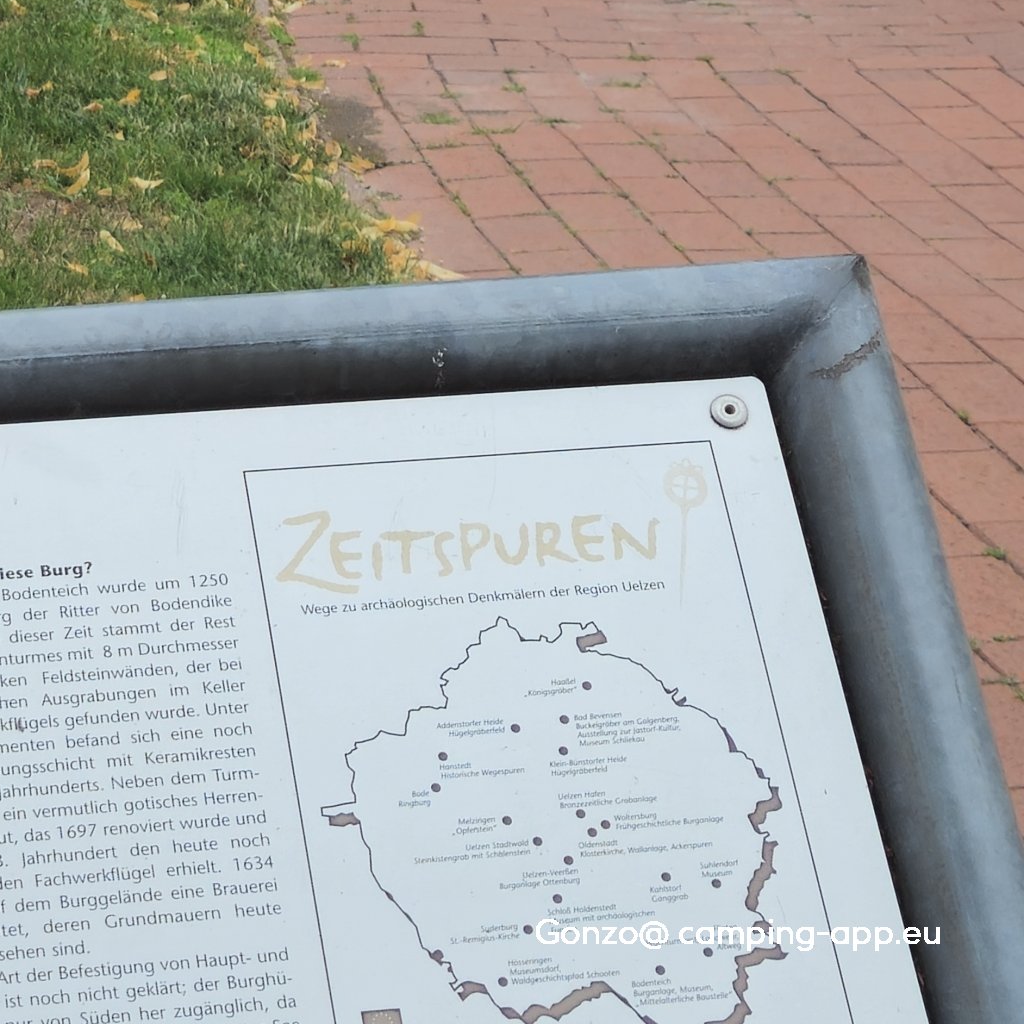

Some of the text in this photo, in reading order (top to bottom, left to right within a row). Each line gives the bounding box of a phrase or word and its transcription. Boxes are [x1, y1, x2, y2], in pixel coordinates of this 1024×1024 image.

[39, 560, 92, 579] Burg?
[0, 582, 89, 601] Bodenteich
[96, 578, 146, 594] wurde
[154, 579, 180, 591] um
[188, 572, 228, 588] 1250
[300, 579, 665, 617] Wege zu archäologischen Denkmälern der Region Uelzen
[22, 606, 49, 622] der
[58, 604, 100, 619] Ritter
[110, 602, 140, 615] von
[150, 593, 232, 612] Bodendike
[8, 628, 54, 644] dieser
[63, 624, 94, 640] Zeit
[101, 620, 162, 637] stammt
[169, 617, 195, 632] der
[203, 615, 236, 630] Rest
[67, 646, 94, 661] mit
[102, 644, 113, 659] 8
[117, 645, 133, 657] m
[137, 638, 239, 656] Durchmesser
[41, 662, 178, 685] Feldsteinwänden,
[185, 659, 212, 674] der
[217, 657, 242, 672] bei
[40, 687, 157, 708] Ausgrabungen
[168, 683, 190, 697] im
[201, 678, 246, 695] Keller
[63, 708, 140, 731] gefunden
[144, 703, 200, 720] wurde.
[204, 701, 249, 716] Unter
[64, 730, 121, 749] befand
[130, 728, 161, 744] sich
[169, 726, 204, 741] eine
[212, 721, 253, 738] noch
[51, 939, 90, 957] sind.
[25, 966, 53, 983] der
[57, 961, 155, 980] Befestigung
[158, 958, 190, 971] von
[195, 951, 252, 971] Haupt-
[256, 945, 289, 963] und
[3, 993, 23, 1009] ist
[29, 988, 71, 1006] noch
[77, 985, 120, 1002] nicht
[125, 980, 187, 1003] geklärt;
[193, 976, 220, 993] der
[226, 970, 292, 992] Burghü-
